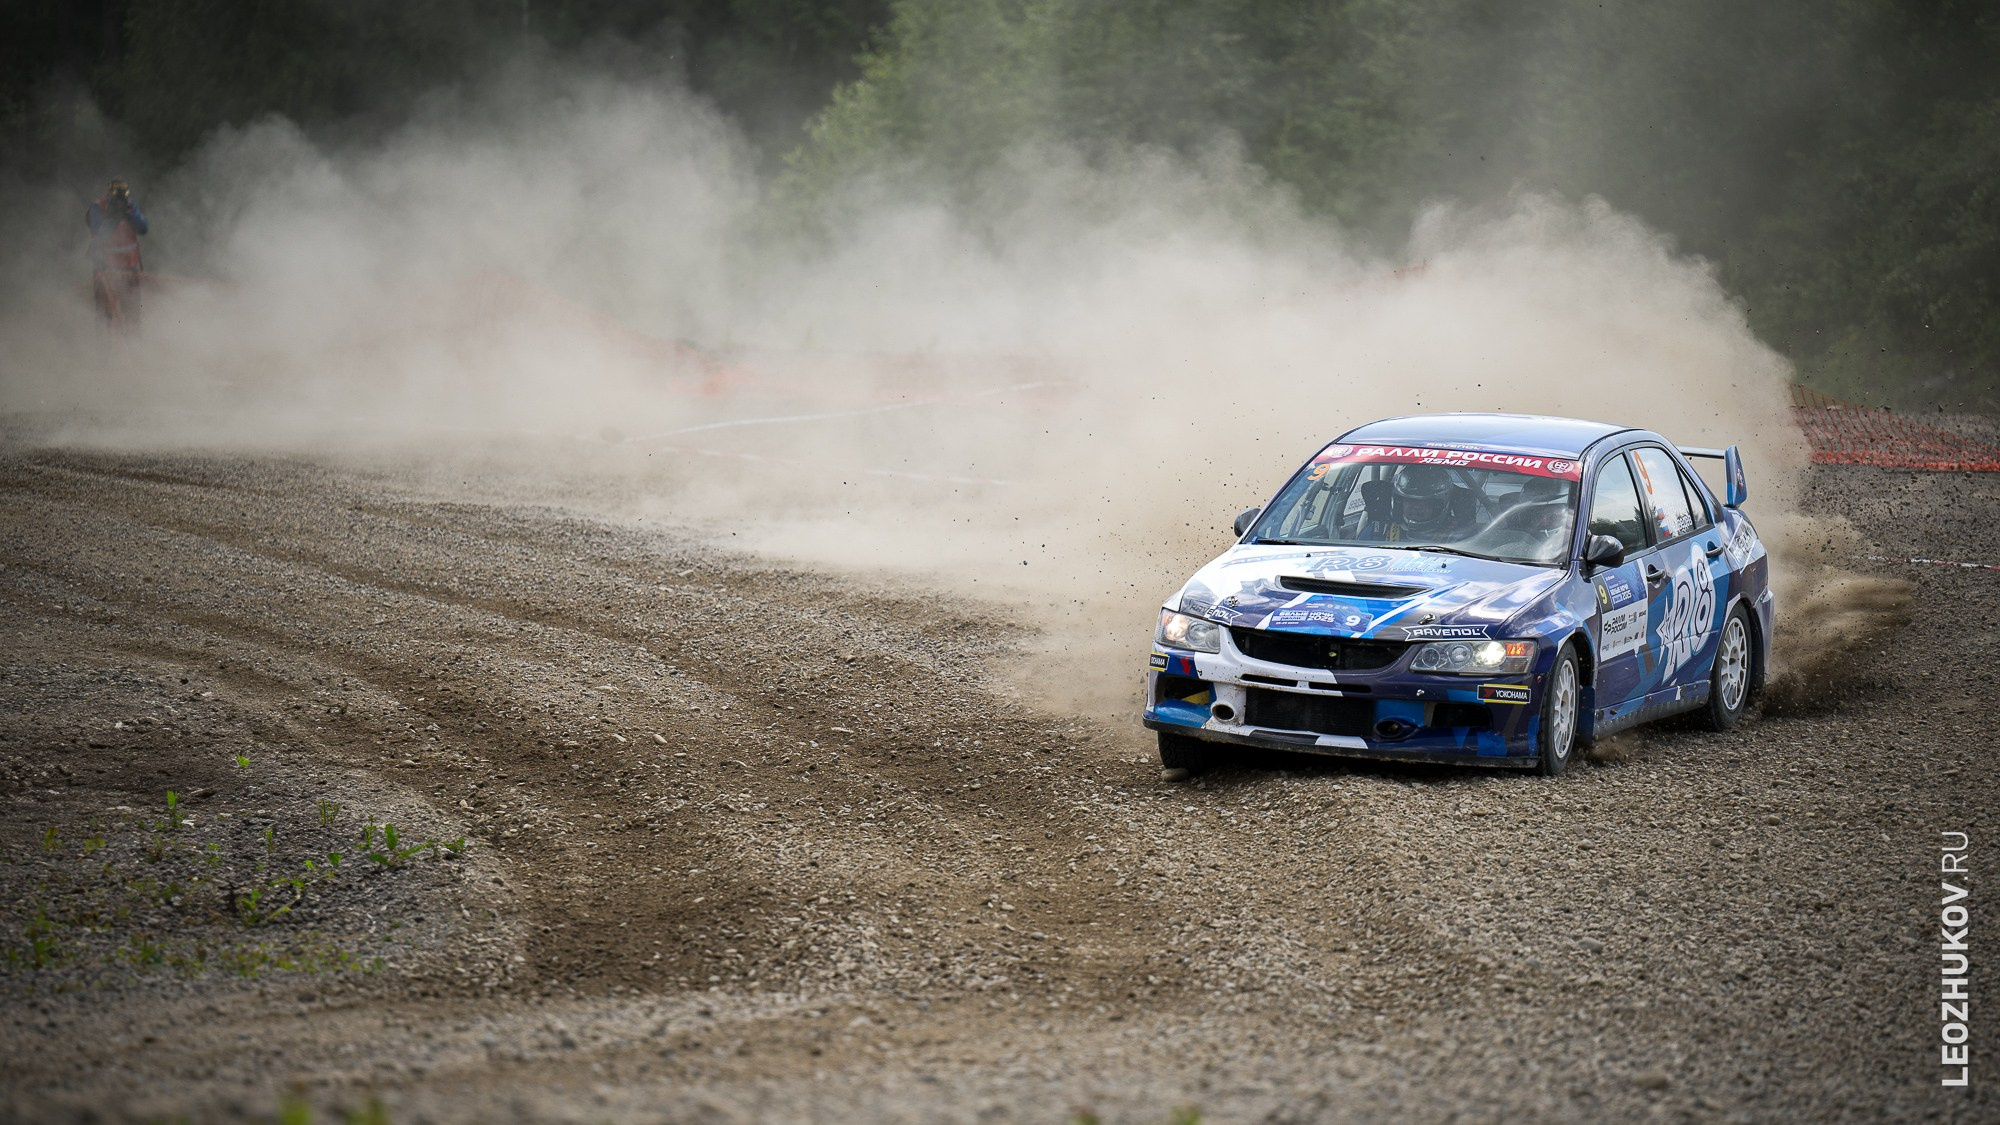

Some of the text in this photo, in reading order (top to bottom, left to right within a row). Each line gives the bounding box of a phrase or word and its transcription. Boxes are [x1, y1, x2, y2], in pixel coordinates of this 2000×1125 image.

[1356, 447, 1439, 458] РАЛЛИ
[1445, 450, 1542, 469] РОССИИ
[1307, 463, 1331, 481] 9
[1633, 450, 1653, 496] 9
[1598, 584, 1608, 605] 9
[1307, 615, 1336, 623] 2025
[1344, 615, 1361, 627] 9
[1413, 628, 1481, 637] RAVENOL
[1495, 689, 1528, 700] YOKOHAMA
